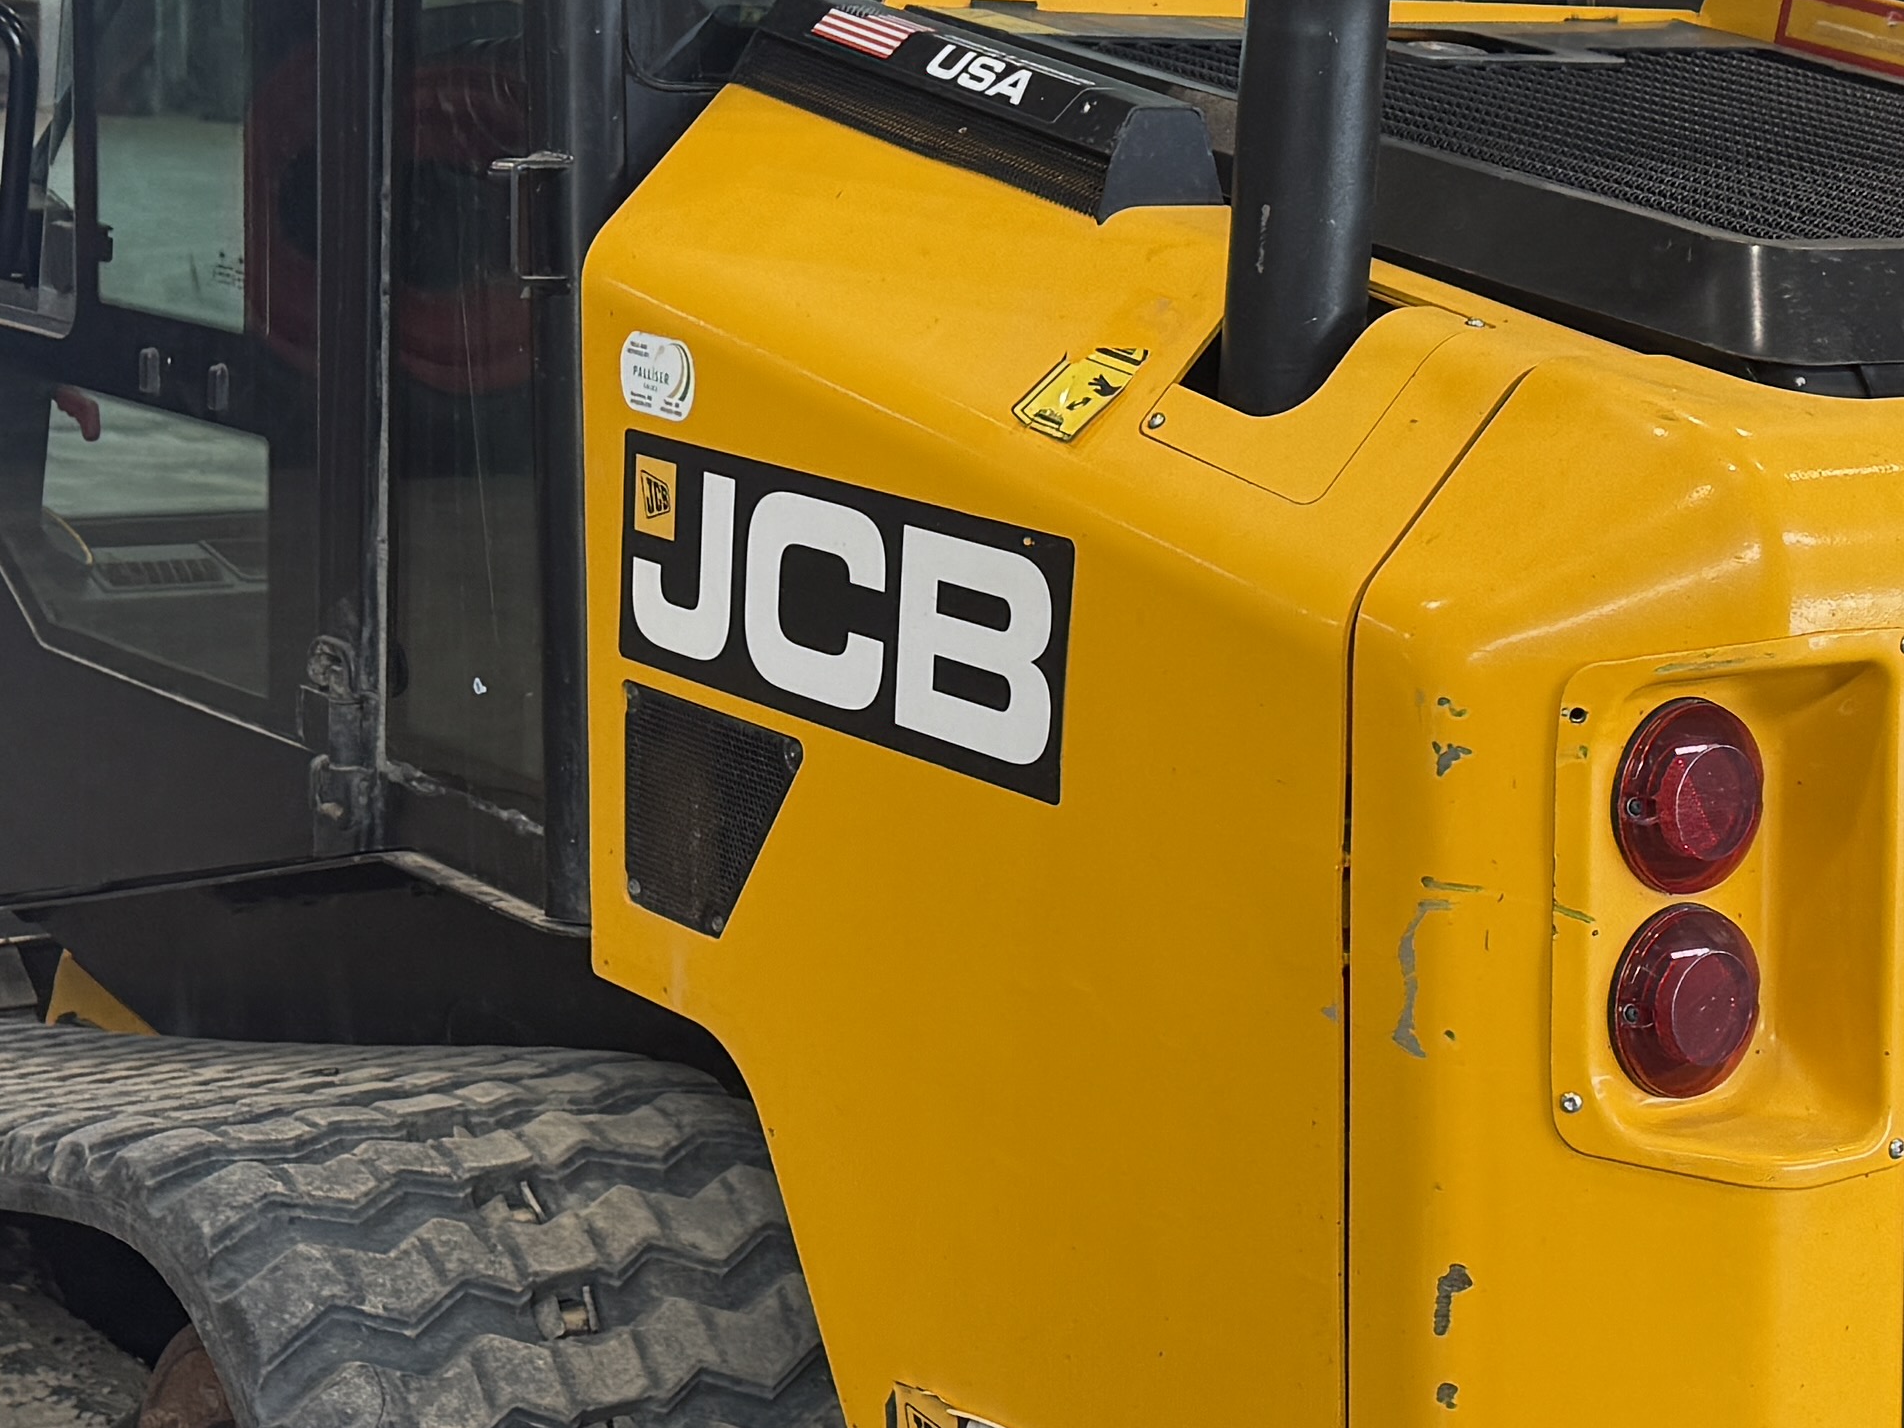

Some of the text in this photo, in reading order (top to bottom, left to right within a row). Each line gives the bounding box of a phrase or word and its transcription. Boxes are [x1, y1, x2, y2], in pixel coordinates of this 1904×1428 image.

[925, 43, 1033, 106] USA
[646, 476, 670, 514] JCB
[632, 471, 1052, 766] JCB
